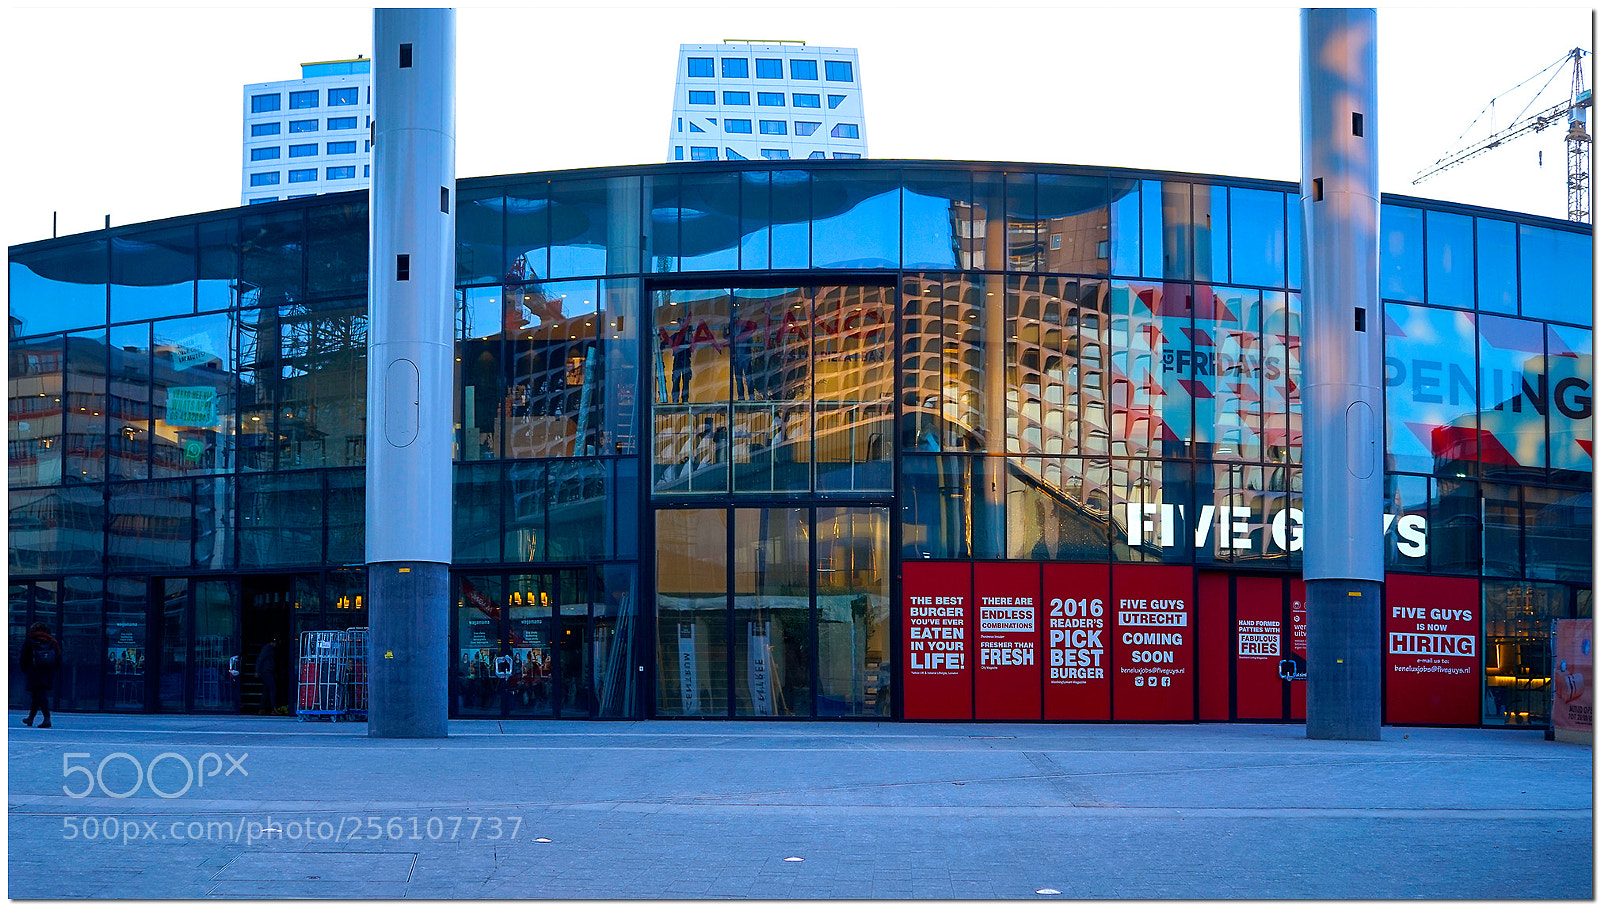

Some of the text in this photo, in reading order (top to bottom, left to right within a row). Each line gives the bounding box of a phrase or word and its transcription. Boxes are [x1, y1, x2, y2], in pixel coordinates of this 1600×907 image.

[1163, 350, 1281, 381] TGI FRIDAYS
[1385, 359, 1592, 420] PENING
[1127, 503, 1427, 558] FIVE GS
[910, 596, 964, 605] THE BEST
[981, 597, 1033, 606] THERE ARE
[1120, 599, 1185, 610] FIVE GUYS
[910, 607, 964, 617] BURGER
[1049, 598, 1104, 617] 2016
[981, 610, 1033, 620] ENDLESS
[1122, 613, 1183, 625] UTRECHT
[1392, 606, 1473, 622] FIVE GUYS
[910, 618, 964, 626] YOU'VE EVER
[1050, 618, 1104, 629] READER'S
[1416, 623, 1448, 632] IS NOW
[910, 627, 964, 640] EATEN
[1050, 629, 1104, 648] PICK
[1122, 632, 1183, 646] COMING
[1241, 635, 1278, 643] FABULOUS
[910, 641, 964, 651] IN YOUR
[1014, 641, 1034, 649] THAN
[1241, 642, 1278, 654] FRIES
[1392, 634, 1473, 655] HIRING
[910, 653, 965, 670] LIFE!
[980, 648, 1034, 666] FRESH
[1050, 648, 1104, 667] BEST
[1131, 650, 1174, 663] SOON
[1050, 667, 1104, 679] BURGER
[1394, 665, 1471, 676] beneluxjobs@fiveguys.nl
